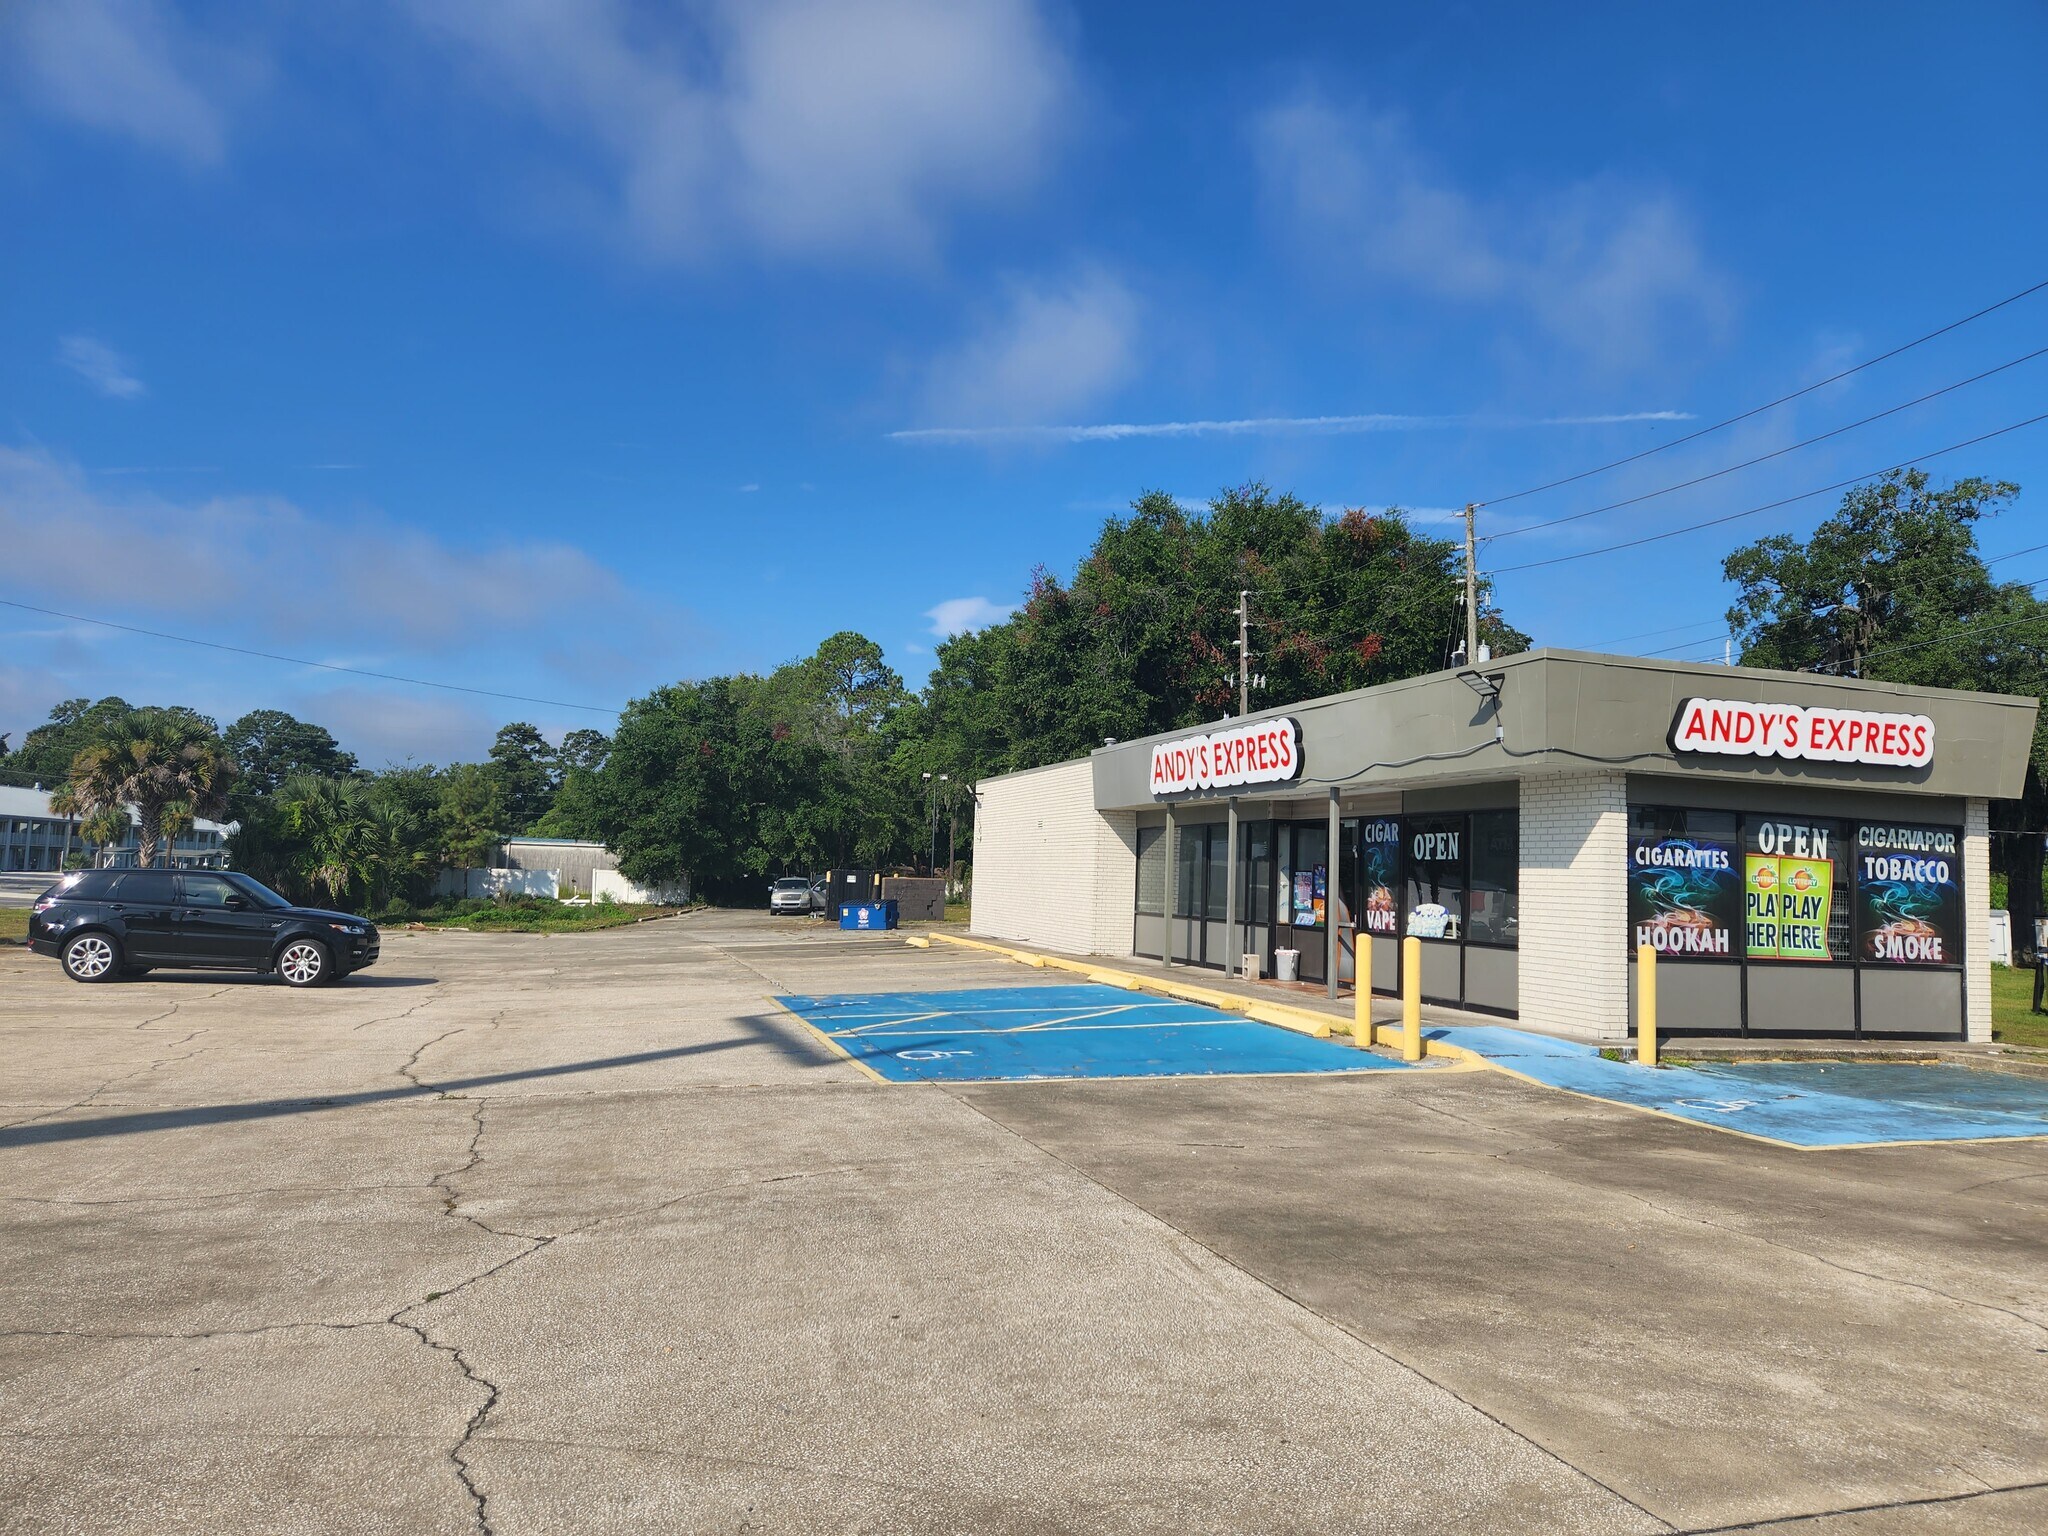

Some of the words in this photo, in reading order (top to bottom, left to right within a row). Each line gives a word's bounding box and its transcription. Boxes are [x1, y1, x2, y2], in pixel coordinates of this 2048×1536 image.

[1684, 707, 1799, 748] ANDY'S
[1810, 717, 1927, 757] EXPRESS
[1154, 745, 1208, 784] ANDY'S
[1213, 729, 1291, 776] EXPRESS
[1365, 823, 1399, 843] CIGAR
[1758, 822, 1829, 859] OPEN
[1413, 832, 1460, 861] OPEN
[1635, 846, 1729, 869] CIGARATTES
[1788, 877, 1817, 886] LOTTERY
[1865, 857, 1949, 884] TOBACCO
[1783, 894, 1823, 920] PLAY
[1366, 910, 1396, 931] VAPE
[1636, 926, 1729, 953] HOOKAH
[1747, 923, 1777, 948] HER
[1782, 924, 1822, 950] HERE
[1874, 934, 1942, 960] SMOKE
